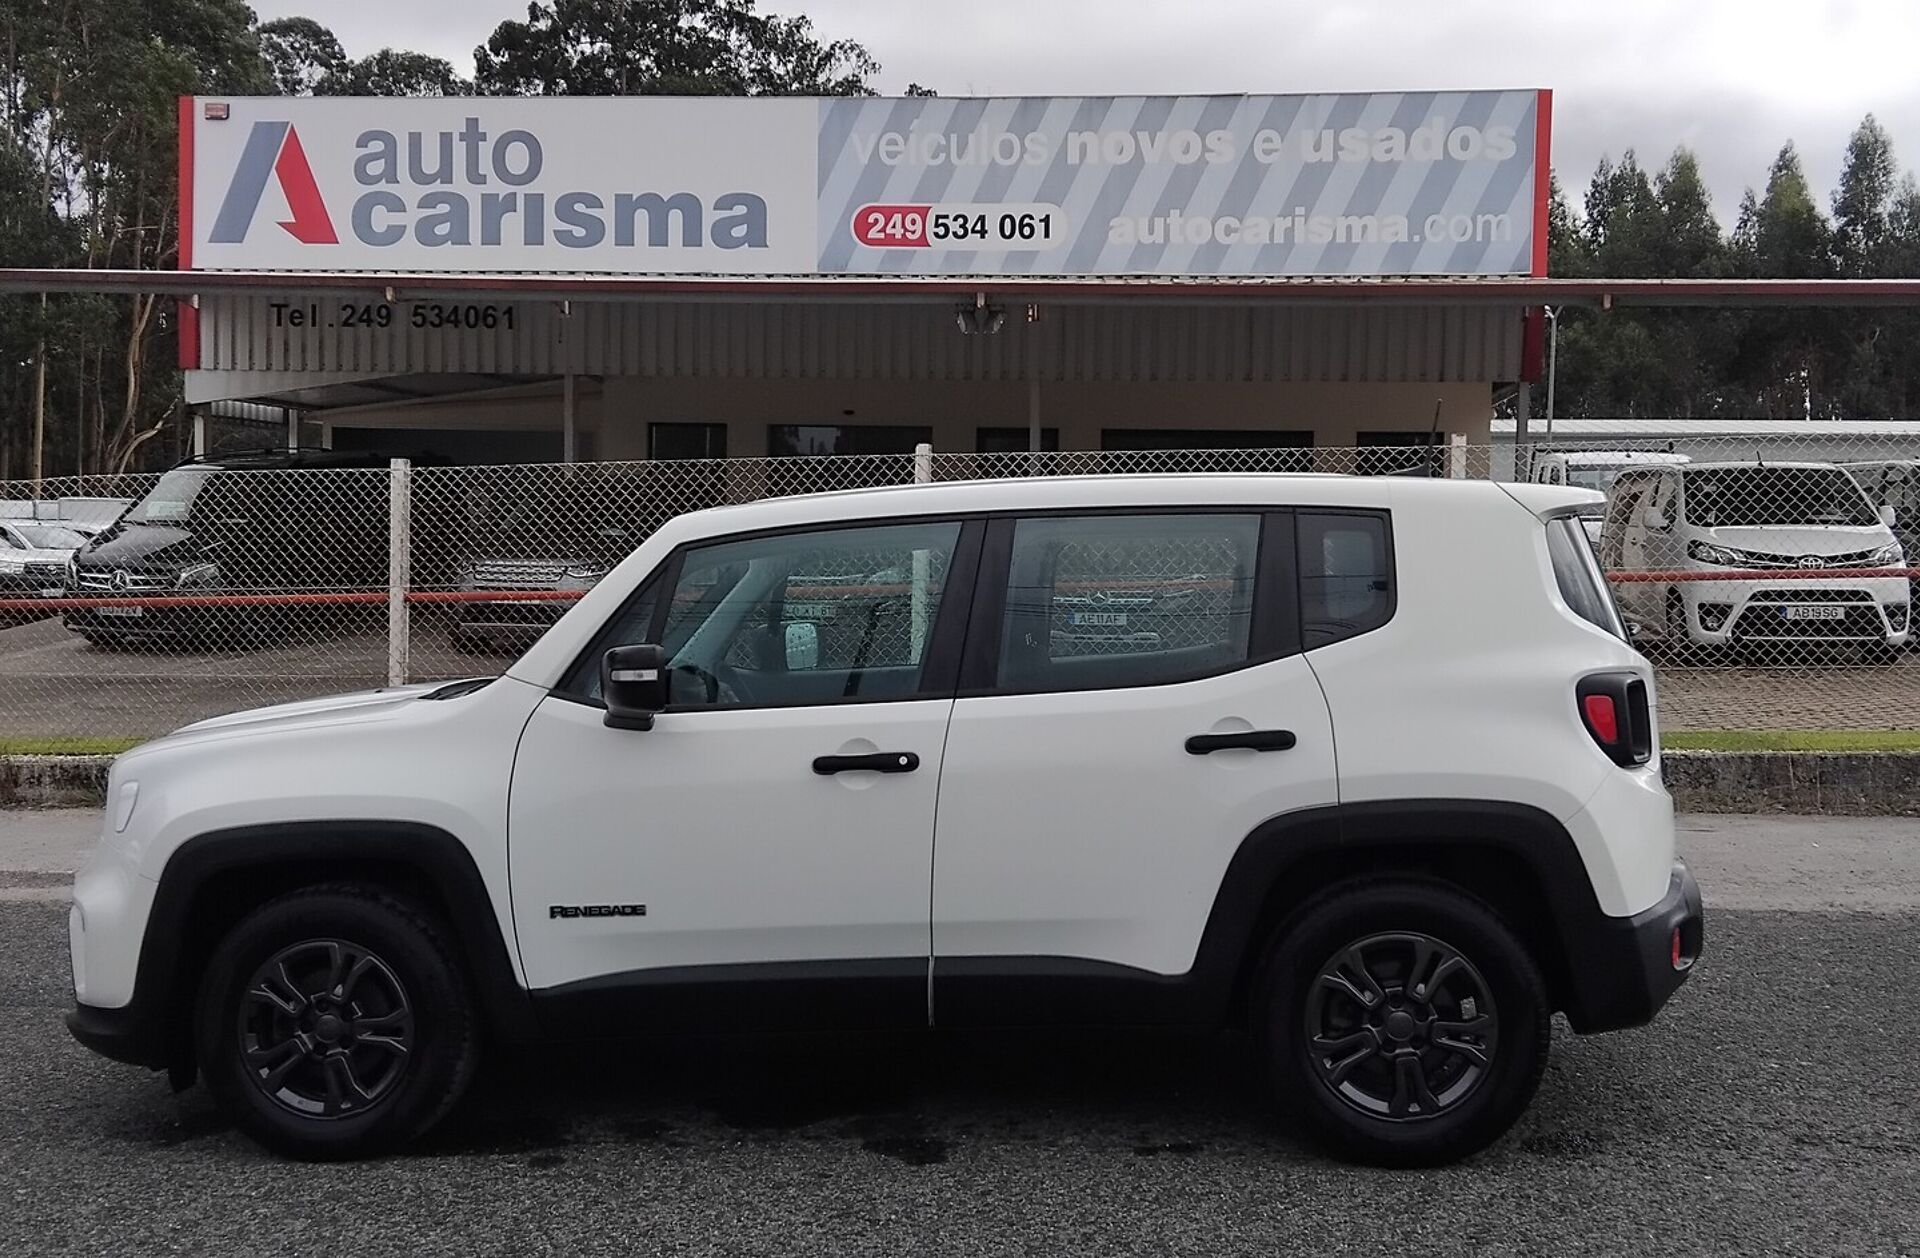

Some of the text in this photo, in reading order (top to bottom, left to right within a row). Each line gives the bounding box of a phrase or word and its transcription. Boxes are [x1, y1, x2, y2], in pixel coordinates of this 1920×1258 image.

[353, 117, 543, 186] auto
[850, 115, 1517, 166] veículos novos e usados
[351, 190, 769, 250] carisma
[867, 211, 1050, 240] 249 534 061
[1108, 206, 1512, 245] autocarisma.com
[411, 304, 515, 330] 534061
[549, 904, 647, 919] RENEGADE
